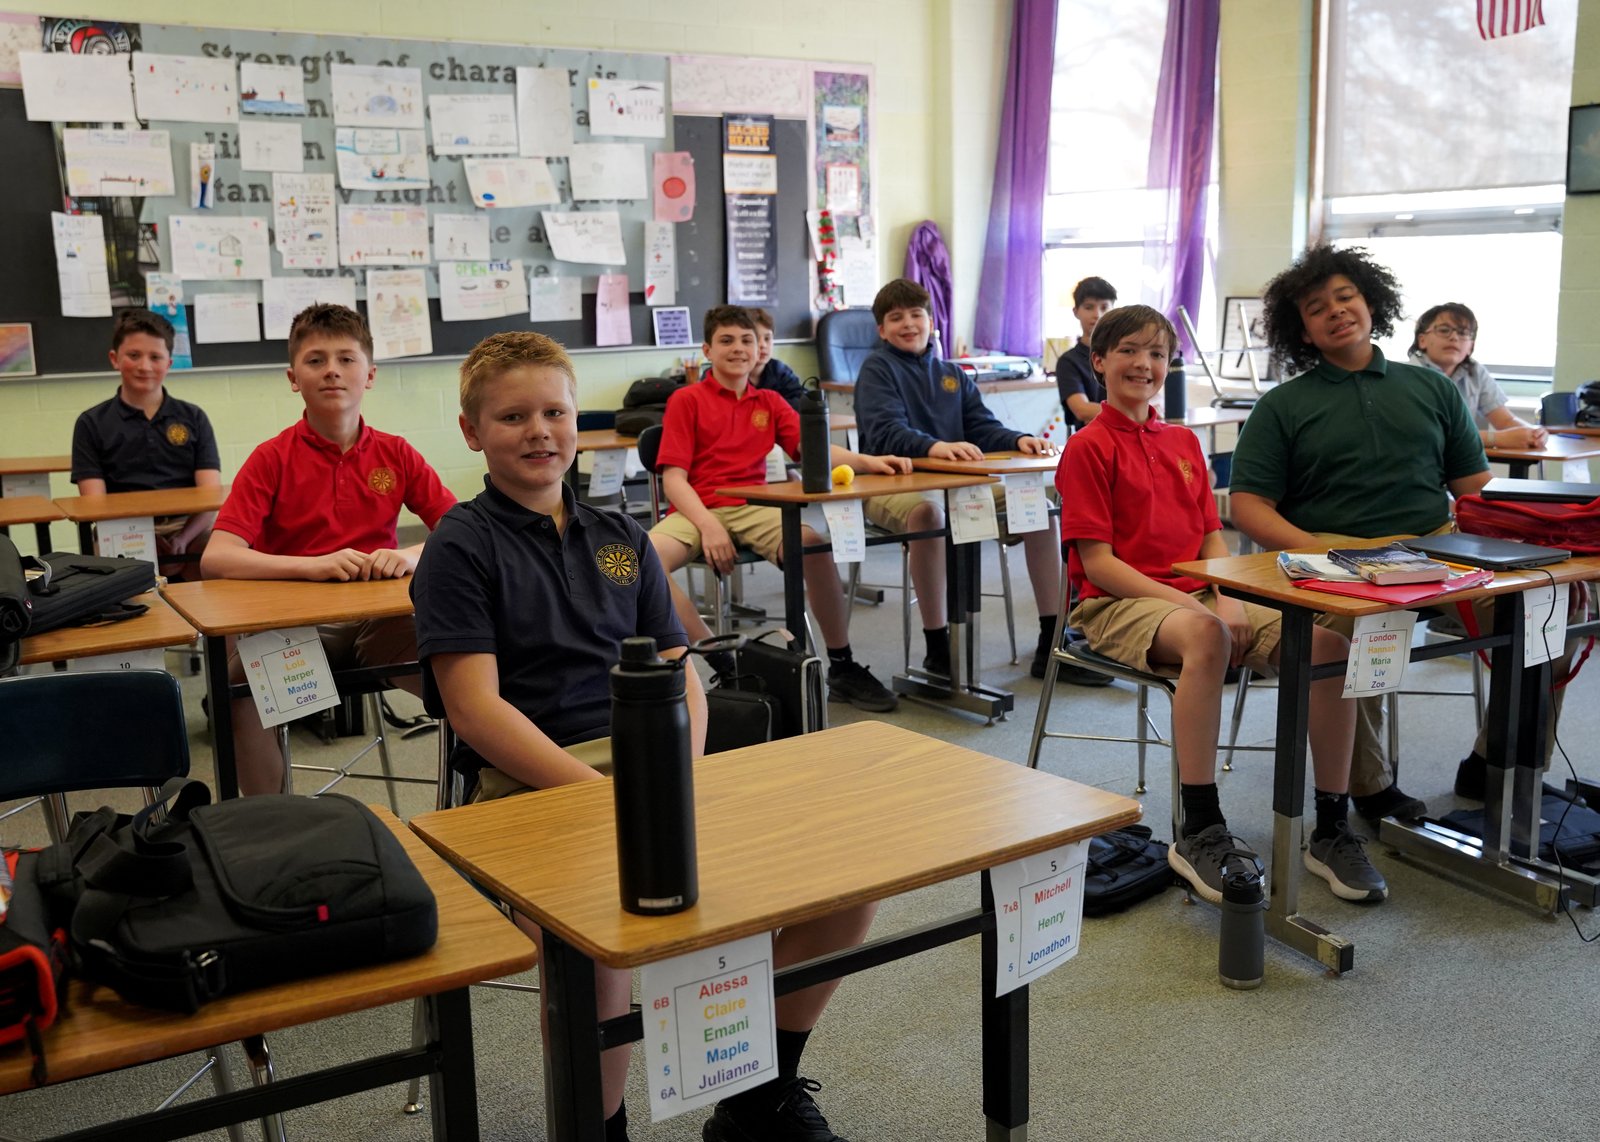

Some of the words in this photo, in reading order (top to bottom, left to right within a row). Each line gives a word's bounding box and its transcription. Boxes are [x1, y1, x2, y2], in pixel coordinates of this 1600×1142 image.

[728, 136, 769, 146] HEART
[456, 264, 487, 276] OPEN
[1369, 634, 1397, 642] London
[283, 648, 301, 659] Lou
[1368, 645, 1396, 654] Hannah
[285, 659, 306, 671] Lola
[1371, 657, 1391, 666] Maria
[283, 669, 314, 684] Harper
[287, 680, 318, 695] Maddy
[296, 693, 317, 705] Cate
[1051, 861, 1057, 872] 5
[1035, 877, 1071, 904] Mitchell
[1009, 934, 1014, 942] 6
[1038, 910, 1065, 932] Henry
[1009, 963, 1013, 972] 5
[1028, 935, 1071, 964] Jonathon
[718, 956, 726, 969] 5
[653, 997, 670, 1010] 6B
[700, 975, 748, 999] Alessa
[660, 1020, 667, 1032] 7
[704, 997, 746, 1020] Claire
[662, 1043, 668, 1053] 8
[704, 1017, 749, 1042] Emani
[663, 1065, 670, 1076] 5
[707, 1041, 749, 1064] Maple
[661, 1087, 676, 1100] 6A
[699, 1059, 759, 1089] Julianne
